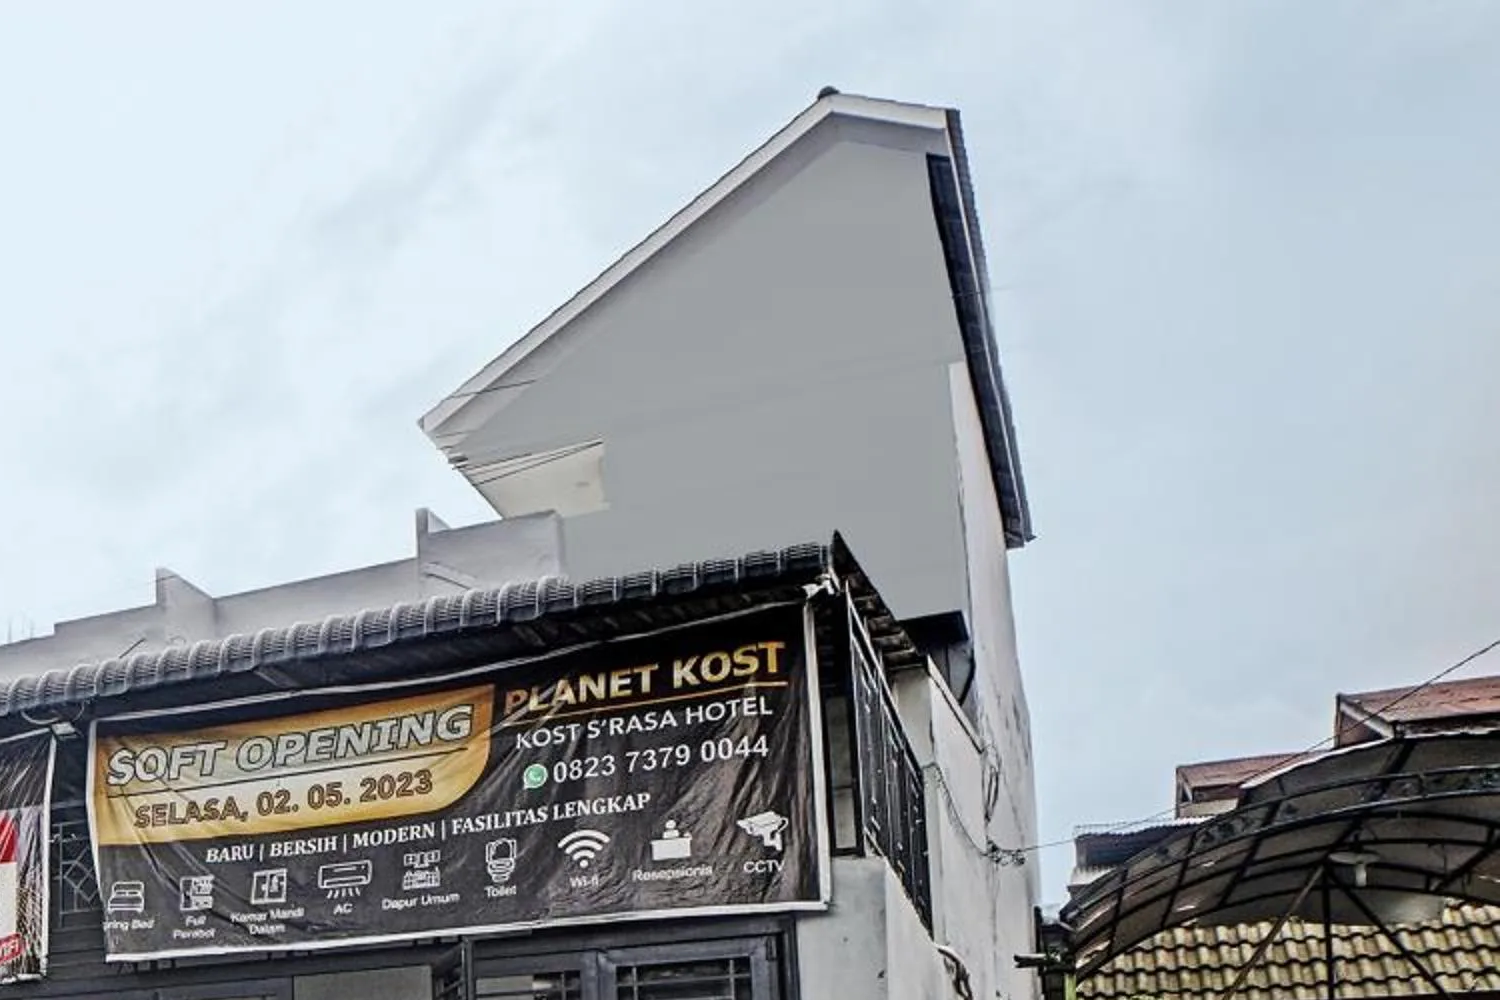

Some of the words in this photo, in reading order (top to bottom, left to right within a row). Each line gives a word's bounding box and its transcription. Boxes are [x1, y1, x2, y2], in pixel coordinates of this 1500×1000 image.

[504, 663, 659, 715] PLANET
[673, 641, 785, 689] KOST
[516, 723, 580, 749] KOST
[587, 711, 677, 740] S'RASA
[685, 696, 773, 725] HOTEL
[106, 739, 227, 786] SOFT
[236, 704, 474, 772] OPENING
[552, 753, 616, 783] 0823
[625, 744, 691, 773] 7379
[700, 735, 769, 763] 0044
[134, 796, 249, 828] SELASA,
[256, 791, 299, 816] 02.
[307, 782, 351, 810] 05.
[359, 769, 434, 803] 2023
[206, 844, 254, 864] BARU
[270, 835, 339, 857] BERSIH
[352, 823, 436, 850] MODERN
[451, 808, 550, 836] FASILITAS
[553, 793, 651, 822] LENGKAP
[632, 864, 713, 882] Resepsionis
[744, 859, 785, 874] CCTV
[484, 884, 517, 898] Toilet
[333, 902, 353, 915] AC
[382, 897, 417, 912] Dapur
[421, 891, 460, 907] Umum
[231, 911, 267, 924] Kamar
[271, 906, 304, 921] Mandi
[103, 919, 129, 932] pring
[132, 919, 155, 930] Bed
[249, 922, 286, 935] Dalam
